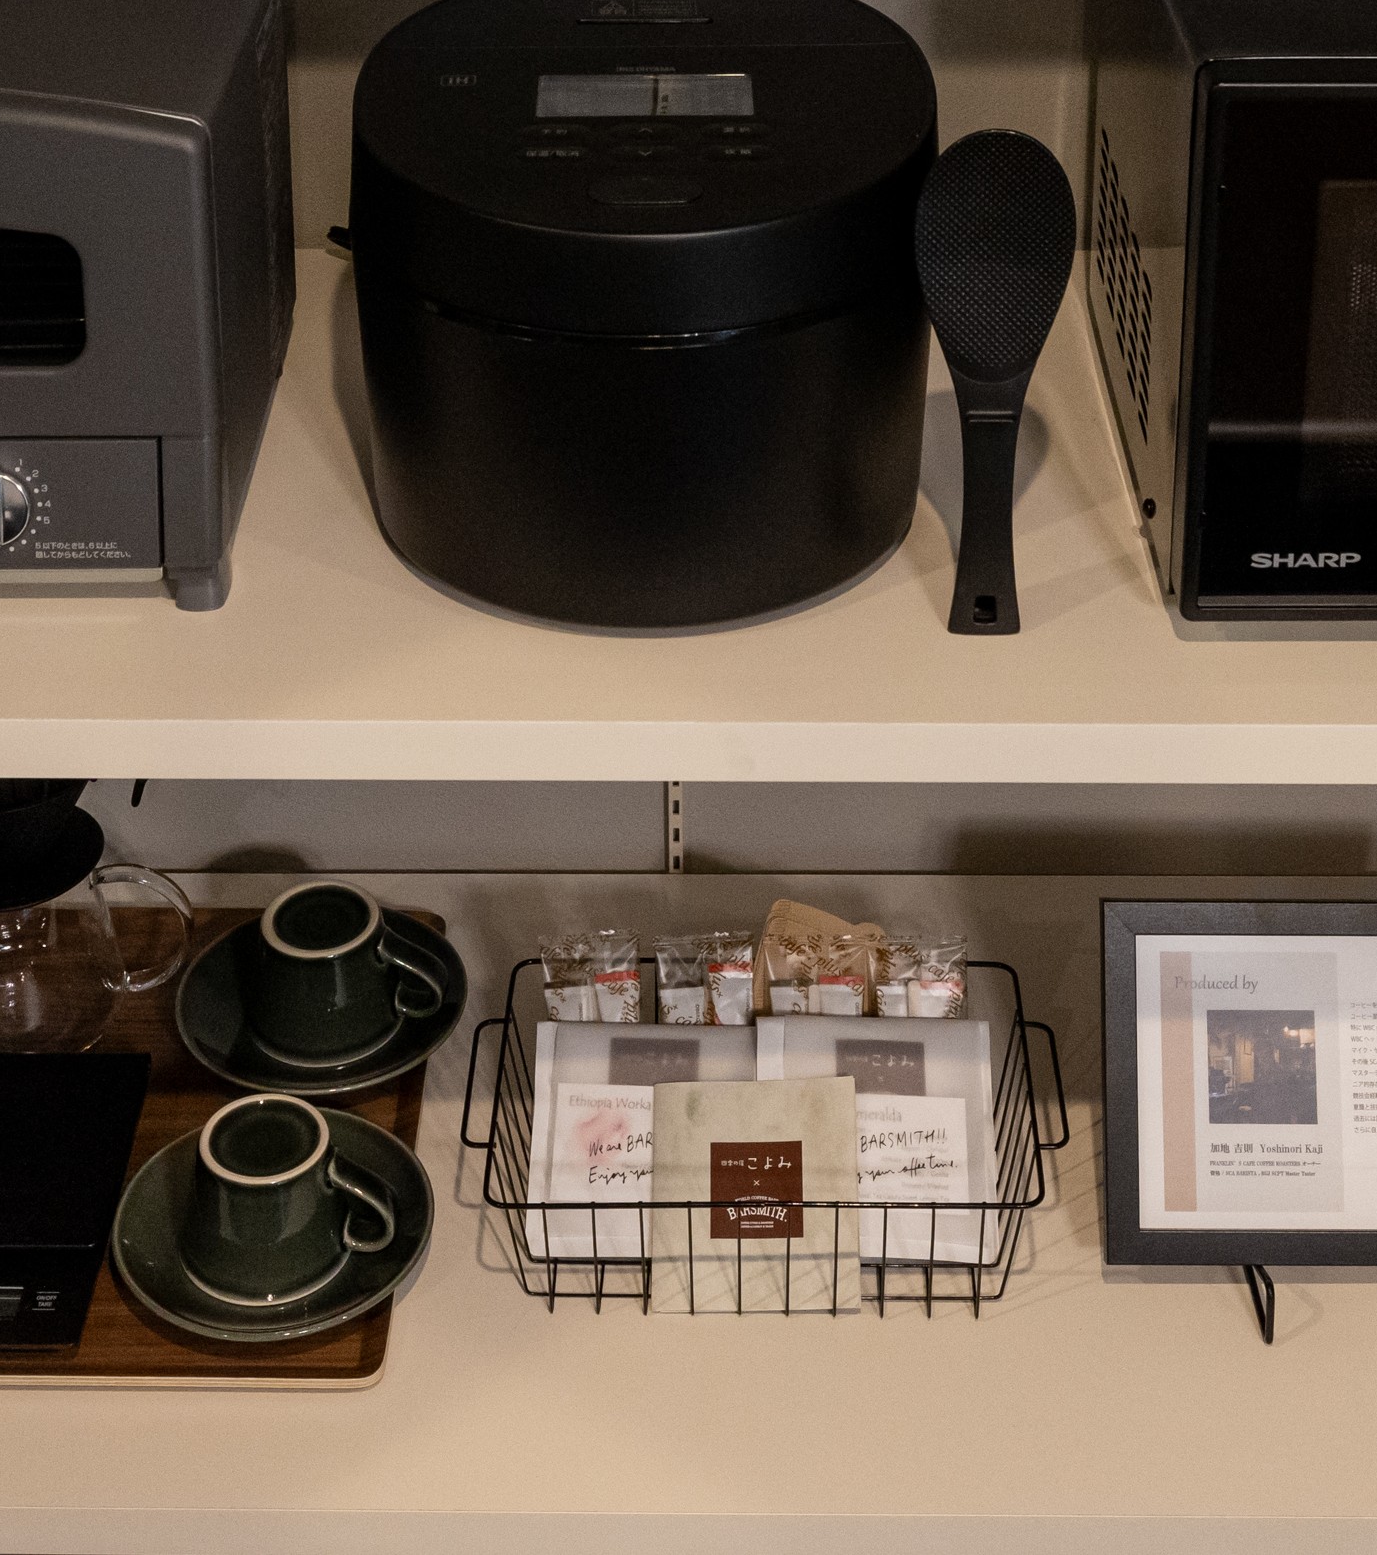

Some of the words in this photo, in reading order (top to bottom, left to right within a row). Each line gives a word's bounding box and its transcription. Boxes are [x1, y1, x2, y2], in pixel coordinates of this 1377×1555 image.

[18, 459, 23, 467] 1
[32, 469, 39, 478] 2
[41, 484, 48, 492] 3
[44, 500, 51, 508] 4
[43, 515, 50, 525] 5
[1250, 552, 1362, 568] SHARP
[1174, 974, 1239, 990] Produced
[1242, 974, 1259, 994] by
[569, 1094, 612, 1108] Ethiopia
[615, 1097, 653, 1112] Worka
[859, 1128, 948, 1153] BARSMITH!!
[1210, 1143, 1230, 1154] 加地
[1234, 1143, 1254, 1154] 吉則
[1259, 1143, 1302, 1154] Yoshinori
[1304, 1143, 1323, 1155] Kaji
[747, 1156, 792, 1170] こよみ
[588, 1165, 628, 1185] Enjoy
